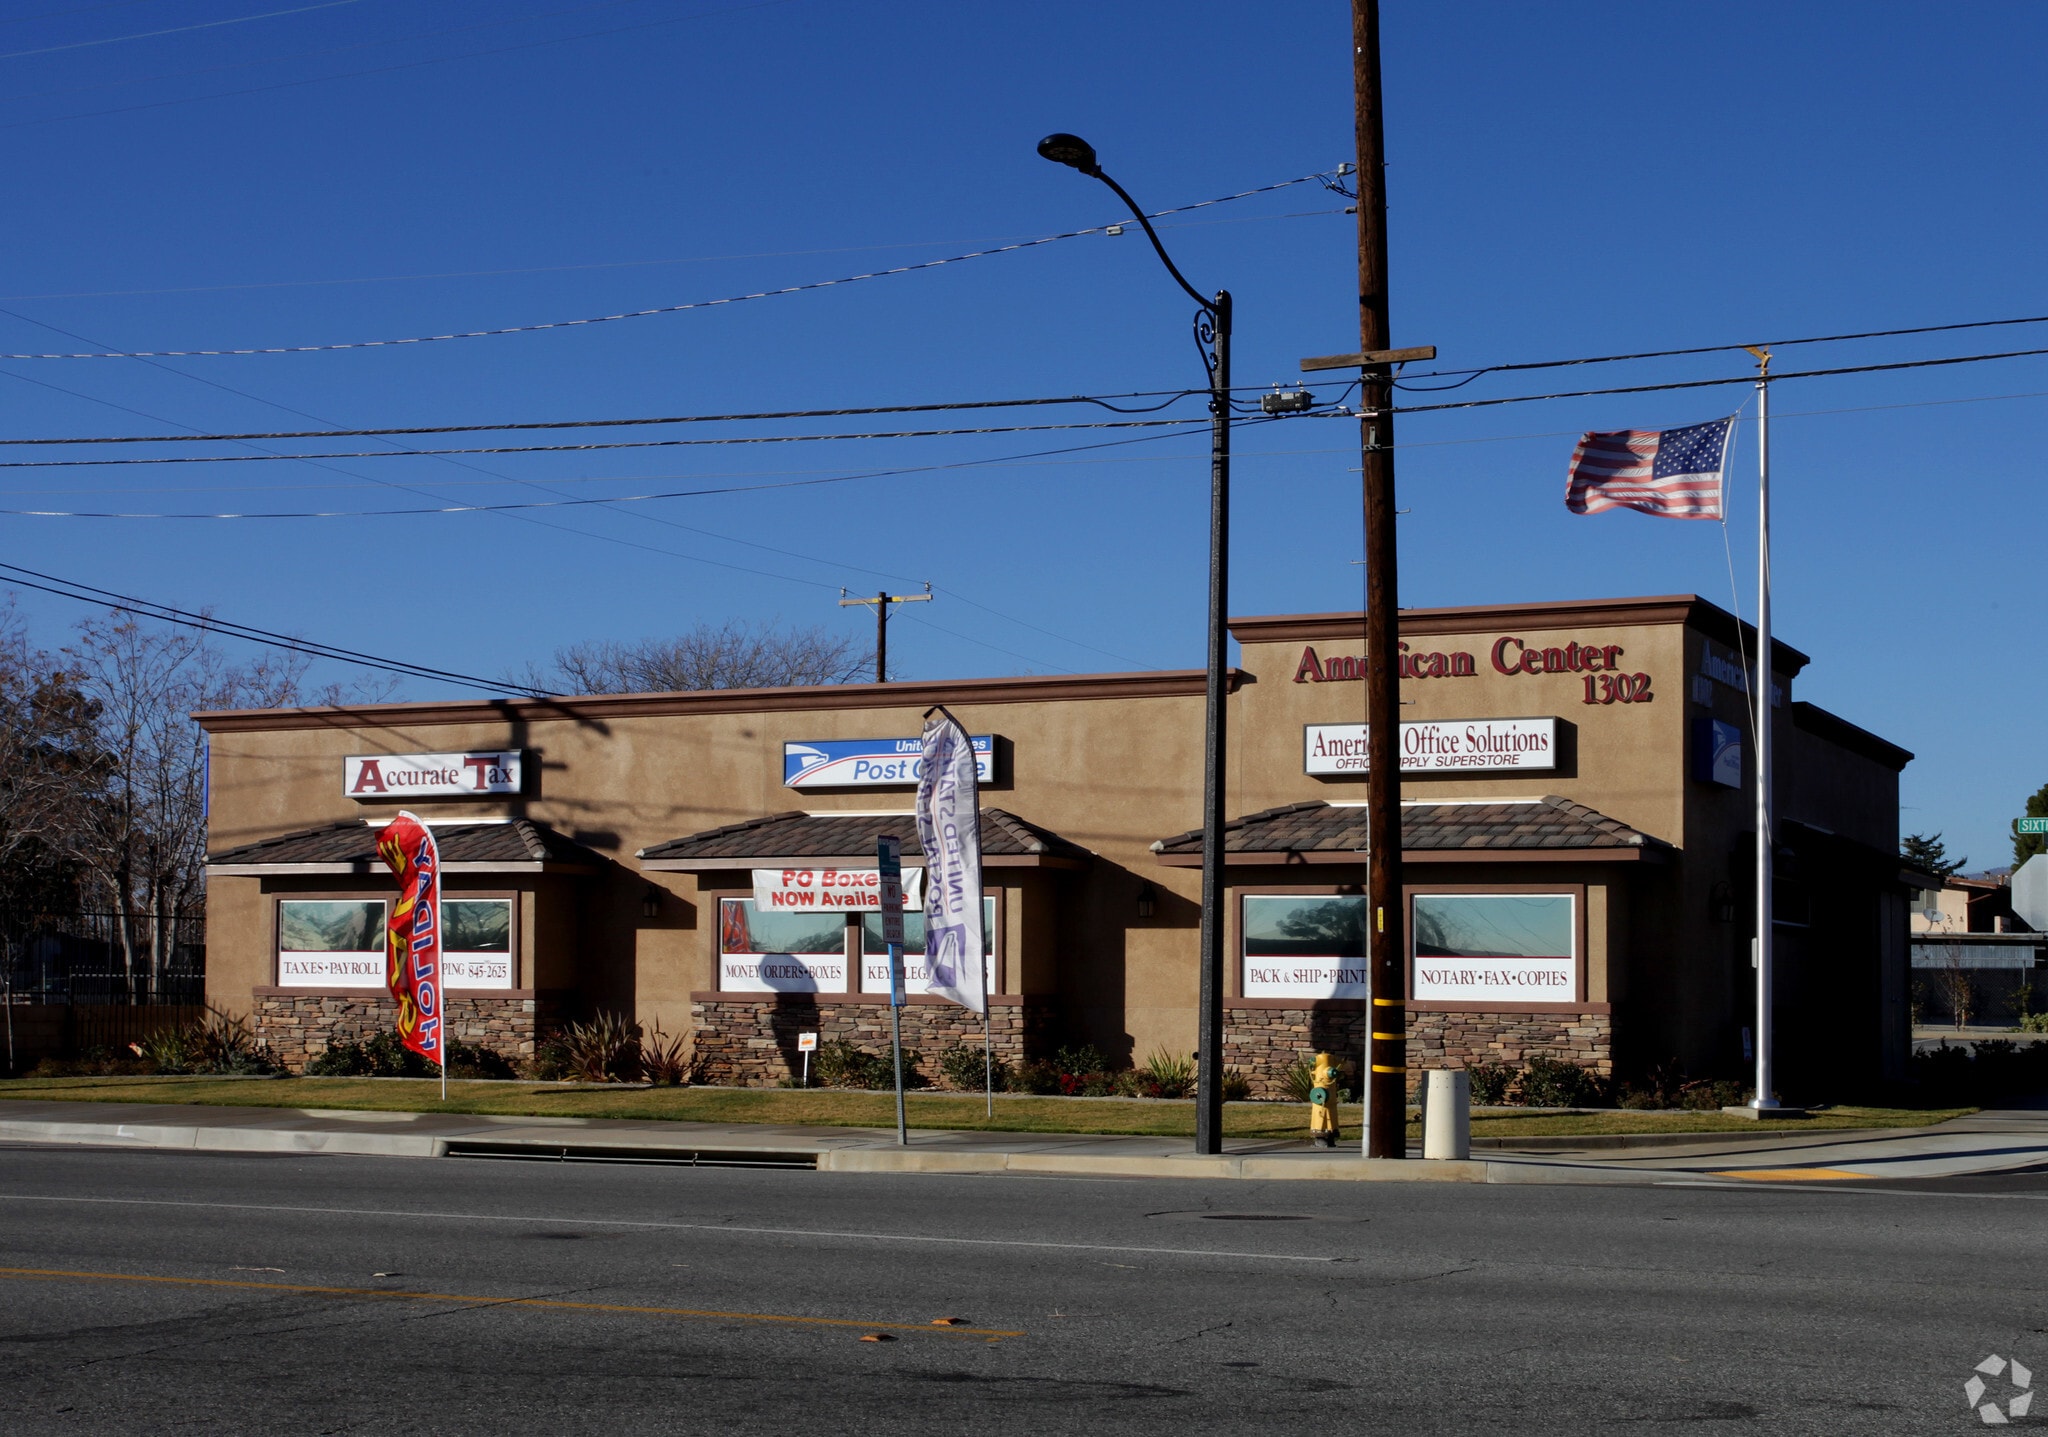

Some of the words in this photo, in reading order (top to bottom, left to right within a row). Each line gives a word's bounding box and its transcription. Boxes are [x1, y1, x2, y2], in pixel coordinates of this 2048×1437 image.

[1292, 641, 1478, 683] Amican
[1490, 636, 1624, 676] Center
[1580, 672, 1654, 705] 1302
[895, 740, 923, 752] Unit
[1312, 729, 1370, 757] Ameri
[1404, 725, 1460, 755] Office
[1465, 724, 1548, 753] Solutions
[853, 760, 906, 780] Post
[1335, 758, 1370, 770] OFFIC
[1435, 754, 1520, 767] SUPERSTORE
[351, 759, 459, 793] Accurate
[463, 755, 513, 790] Tax
[2021, 819, 2048, 831] SIXT
[782, 869, 814, 887] PO
[821, 869, 879, 887] Boxe
[771, 891, 815, 907] NOW
[821, 891, 909, 907] Availae
[468, 965, 507, 979] 845-2625
[725, 965, 760, 978] MONEY
[1250, 969, 1281, 982] PACK
[1284, 972, 1290, 983] &
